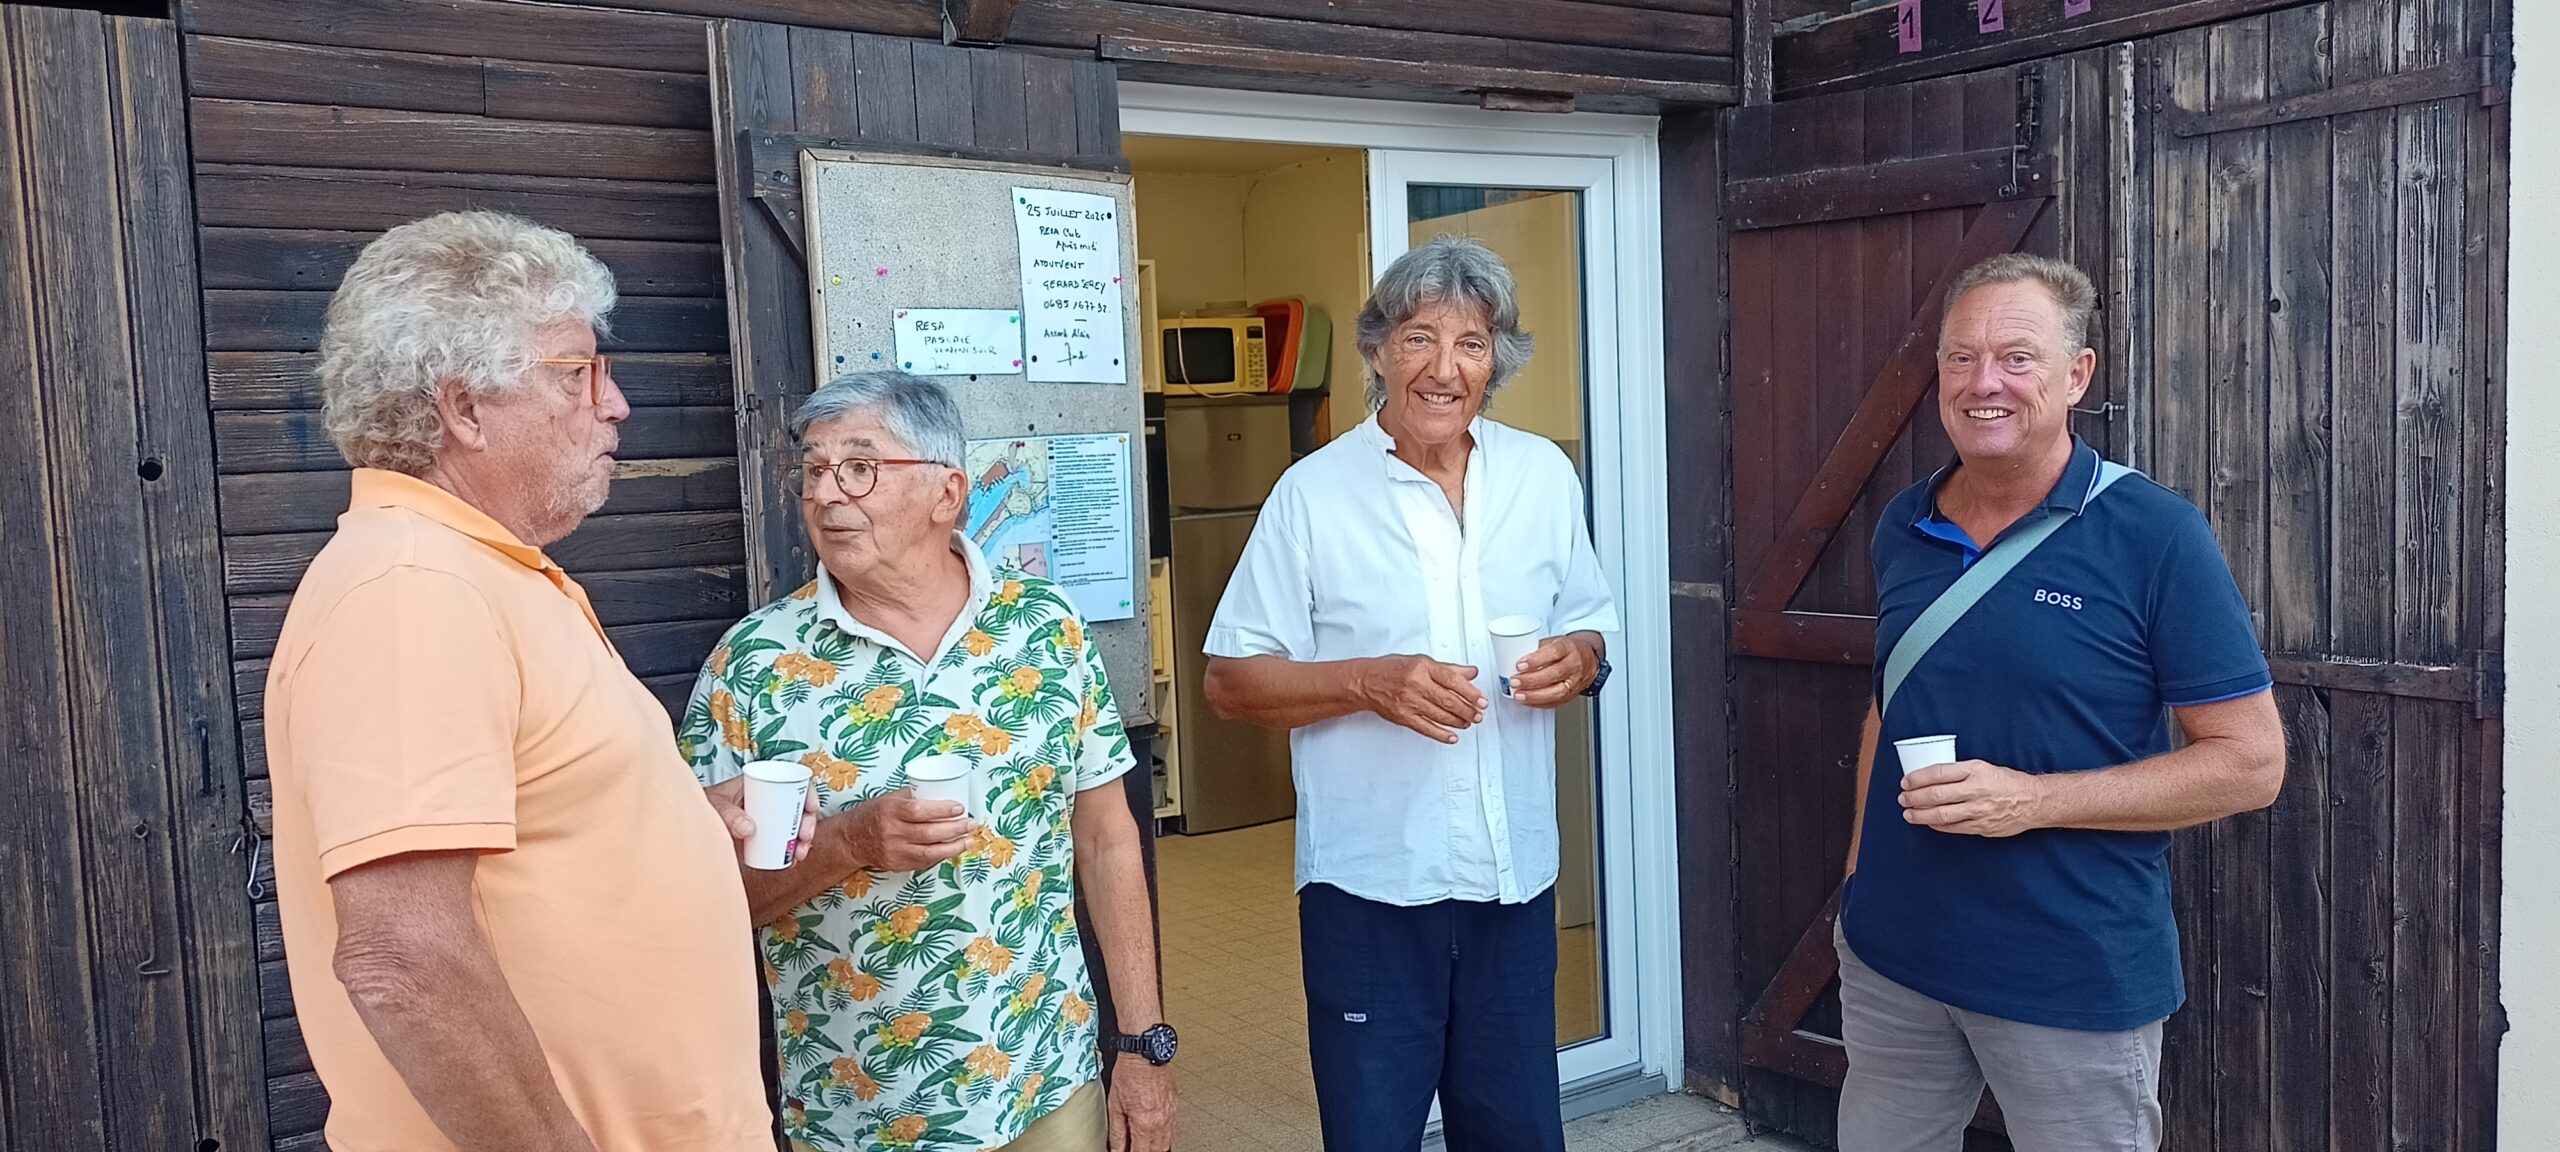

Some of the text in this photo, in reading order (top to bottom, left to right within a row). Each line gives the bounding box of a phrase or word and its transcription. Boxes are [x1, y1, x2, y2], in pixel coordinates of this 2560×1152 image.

[1902, 7, 1914, 39] 1
[1026, 204, 1041, 217] 25
[1045, 206, 1082, 219] JUILLET
[1042, 279, 1080, 291] GERARD
[915, 320, 945, 332] RESA
[2034, 588, 2083, 611] BOSS
